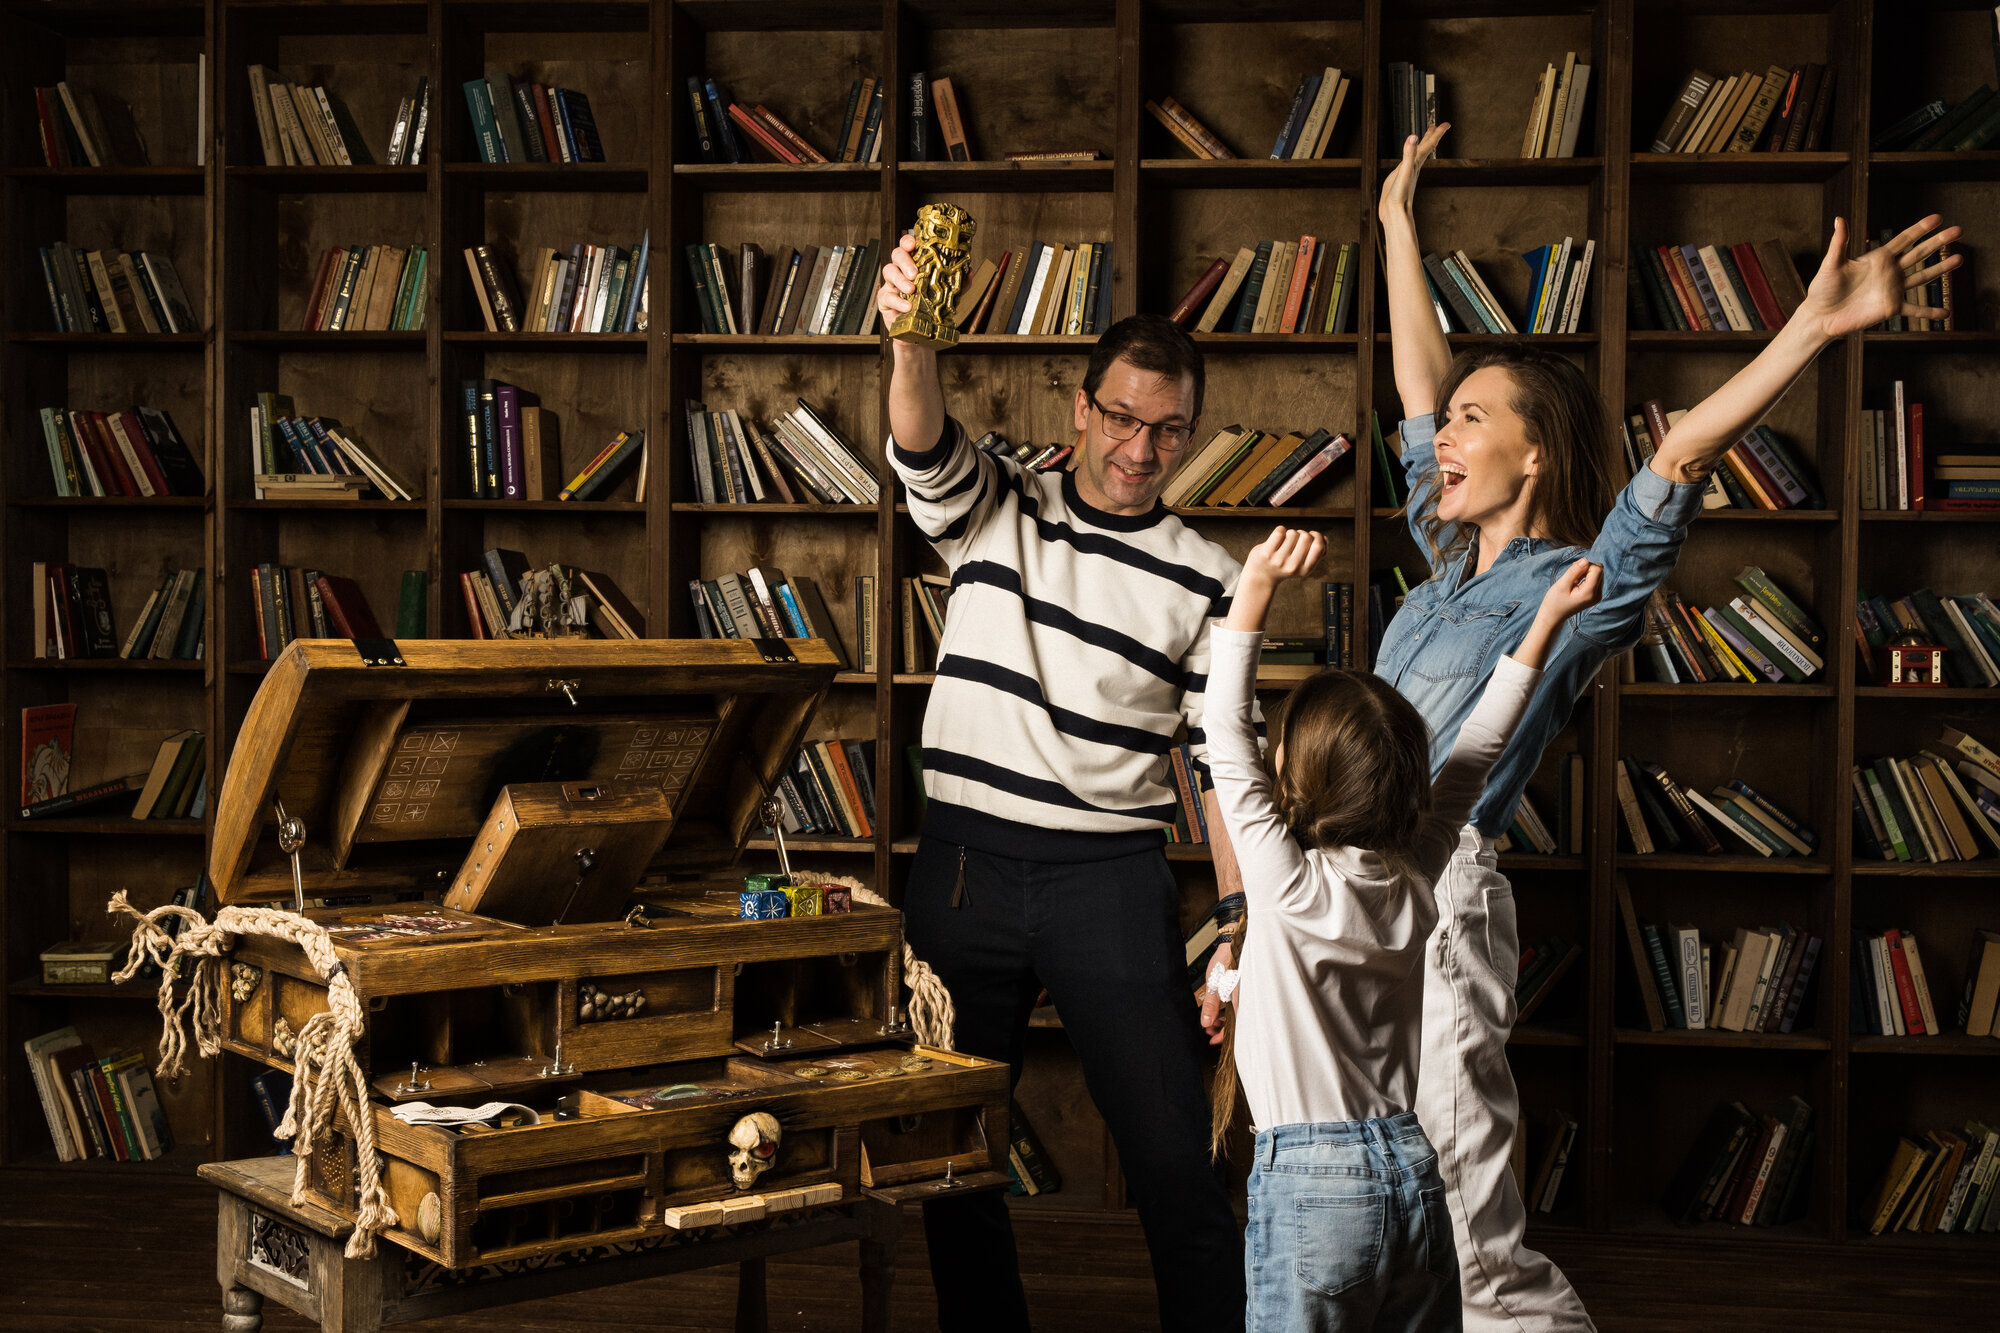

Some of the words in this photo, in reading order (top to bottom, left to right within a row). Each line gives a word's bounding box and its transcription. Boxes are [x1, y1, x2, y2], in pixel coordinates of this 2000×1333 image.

[1775, 637, 1811, 672] ПСИХОЛОГИЯ
[1688, 973, 1697, 1002] МУШКЕТЕРА
[1690, 1005, 1698, 1015] ТРИ
